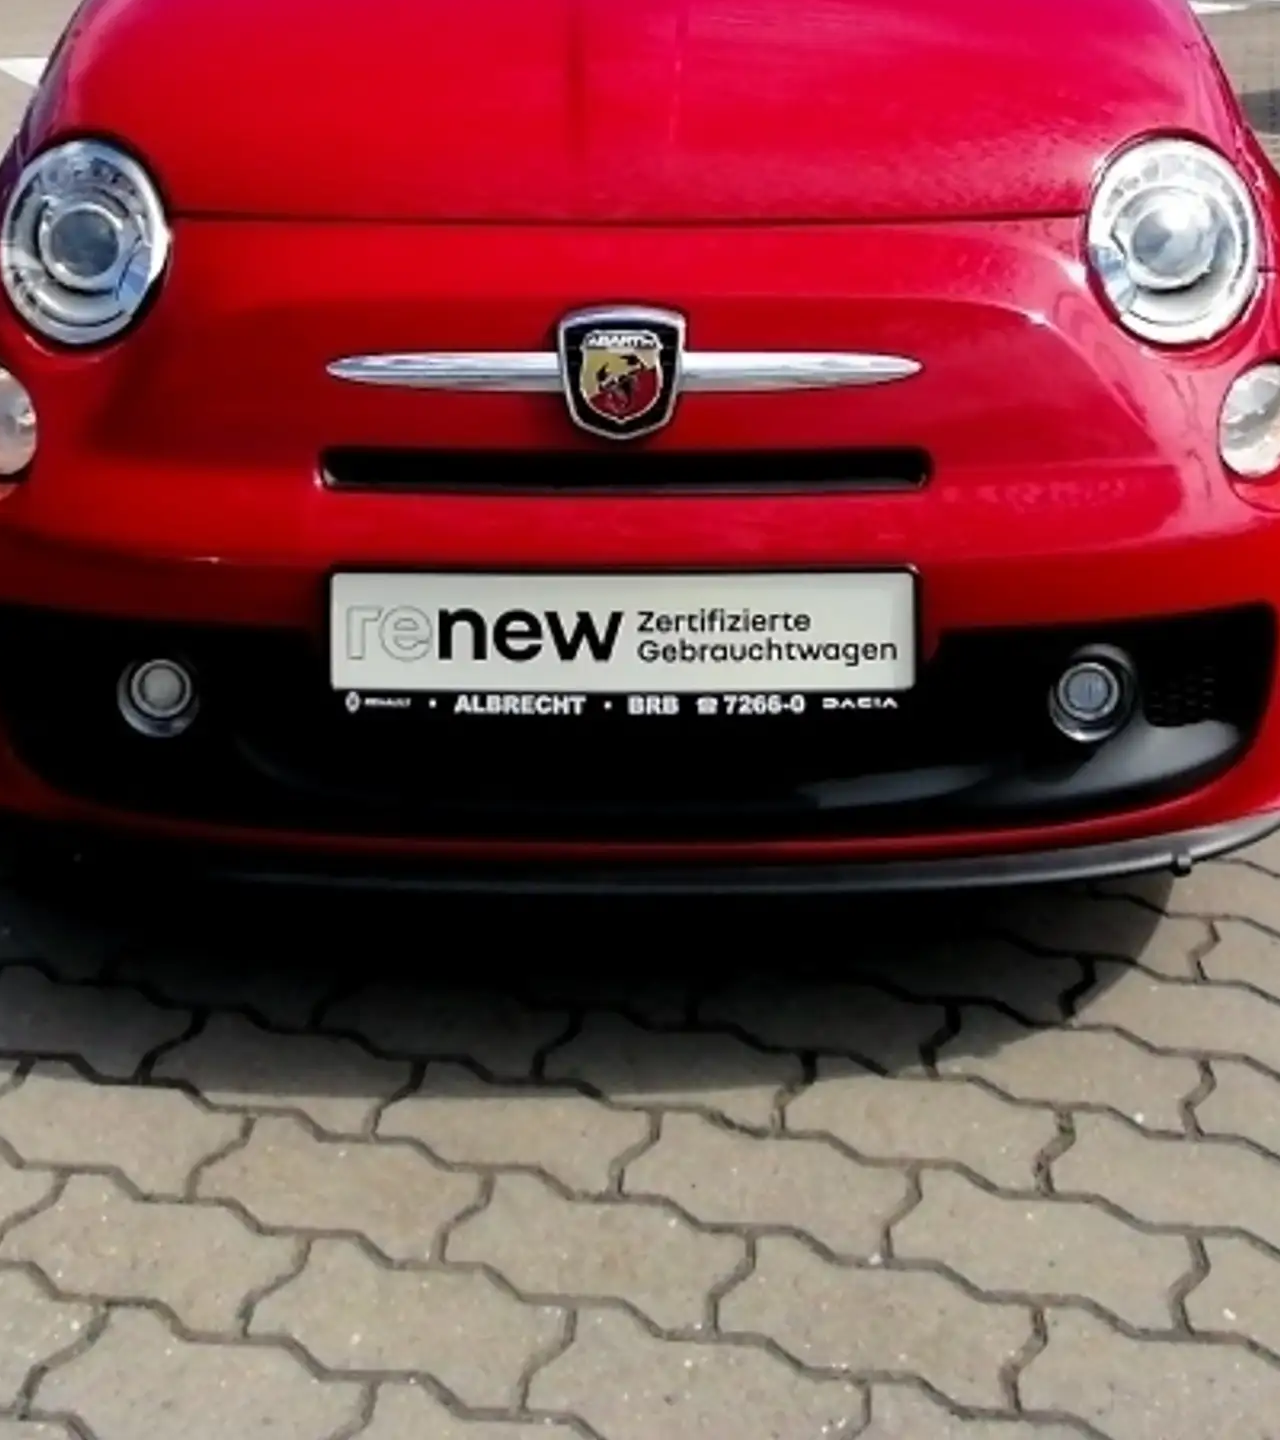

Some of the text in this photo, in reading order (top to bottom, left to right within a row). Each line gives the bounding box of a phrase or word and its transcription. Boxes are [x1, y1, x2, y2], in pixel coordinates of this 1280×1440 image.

[346, 605, 624, 662] renew
[637, 609, 812, 633] Zertifizierte
[637, 638, 898, 667] Gebrauchtwagen
[454, 694, 587, 715] ALBRECHT
[627, 694, 679, 715] BRB
[723, 694, 807, 715] 7266-0
[822, 697, 898, 709] DACIA
